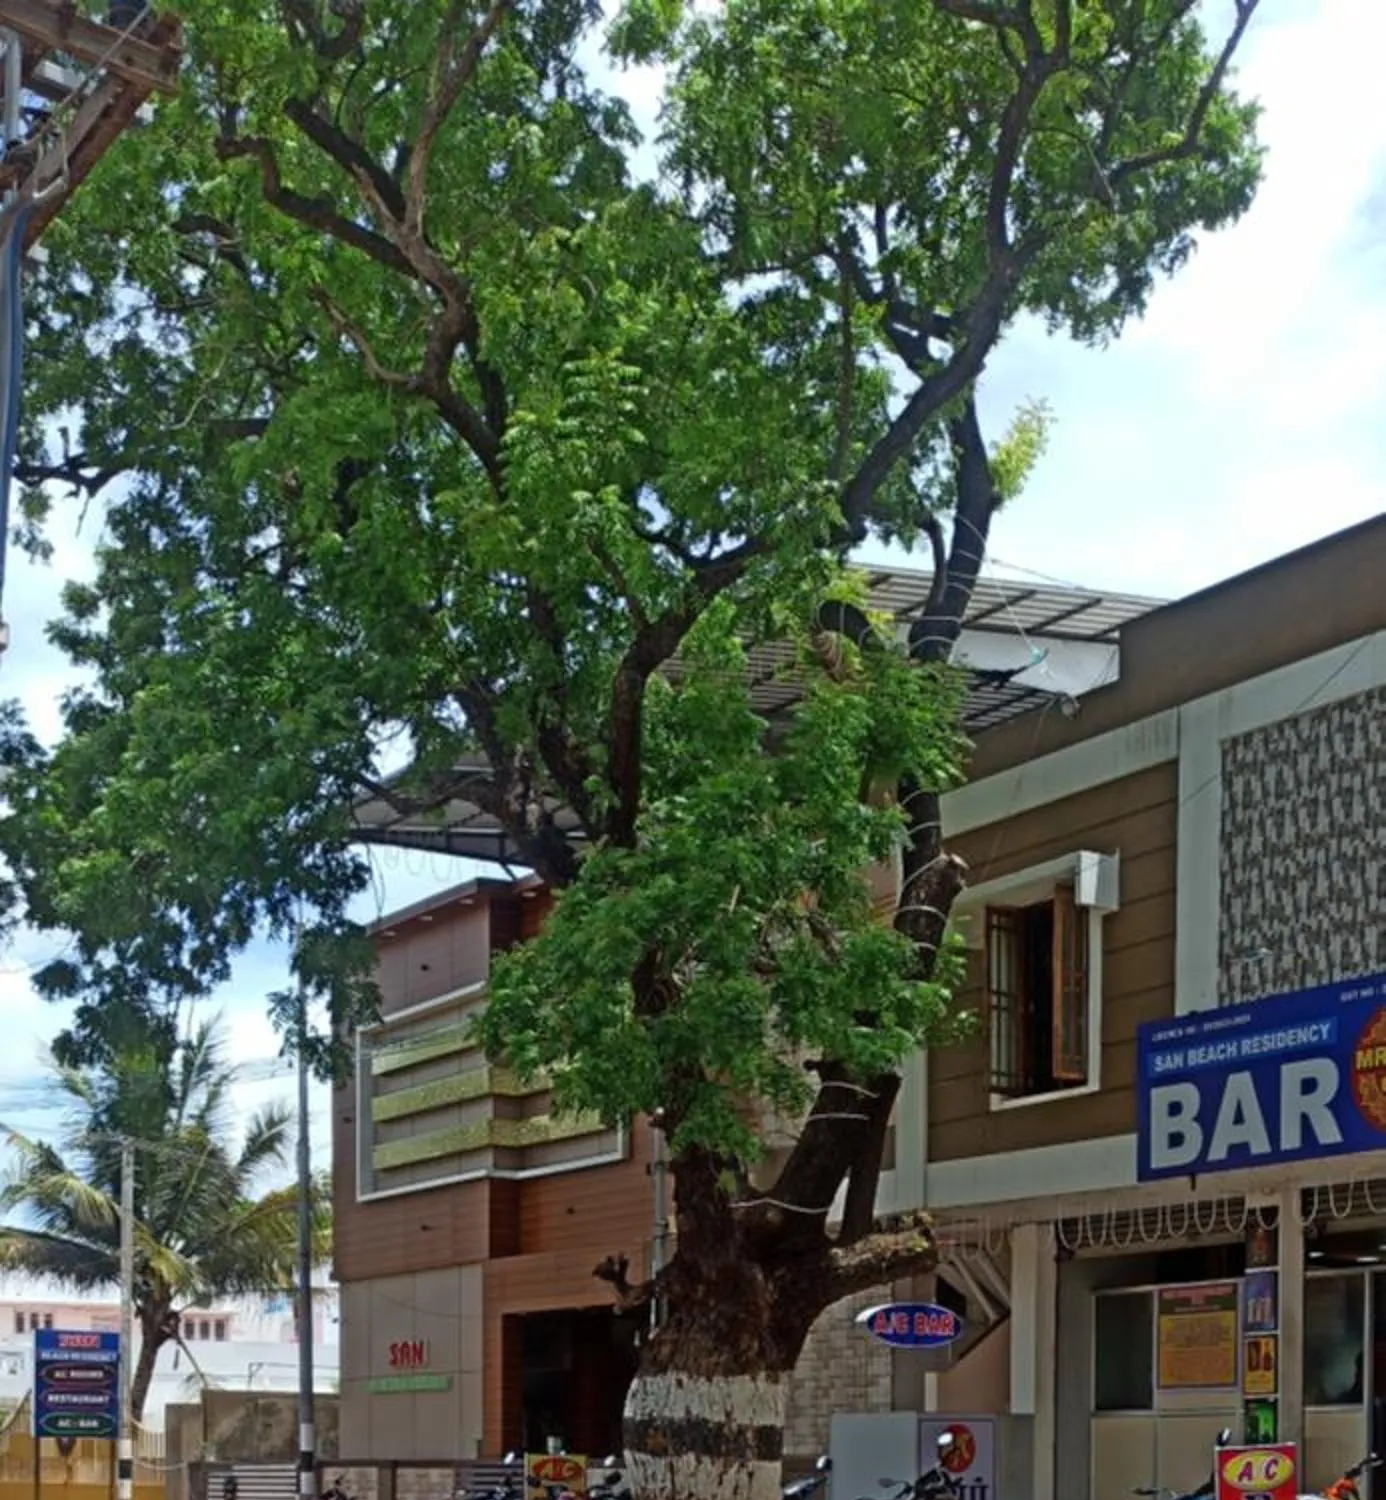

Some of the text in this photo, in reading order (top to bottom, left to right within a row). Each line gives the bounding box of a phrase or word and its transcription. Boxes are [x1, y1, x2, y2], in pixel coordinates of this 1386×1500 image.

[1154, 1054, 1183, 1072] SAN
[1187, 1041, 1239, 1065] BEACH
[1241, 1023, 1331, 1055] RESIDENCY
[1150, 1057, 1344, 1169] BAR
[914, 1311, 955, 1336] BAR
[388, 1340, 425, 1369] SAN
[47, 1393, 109, 1404] RESTAURANT
